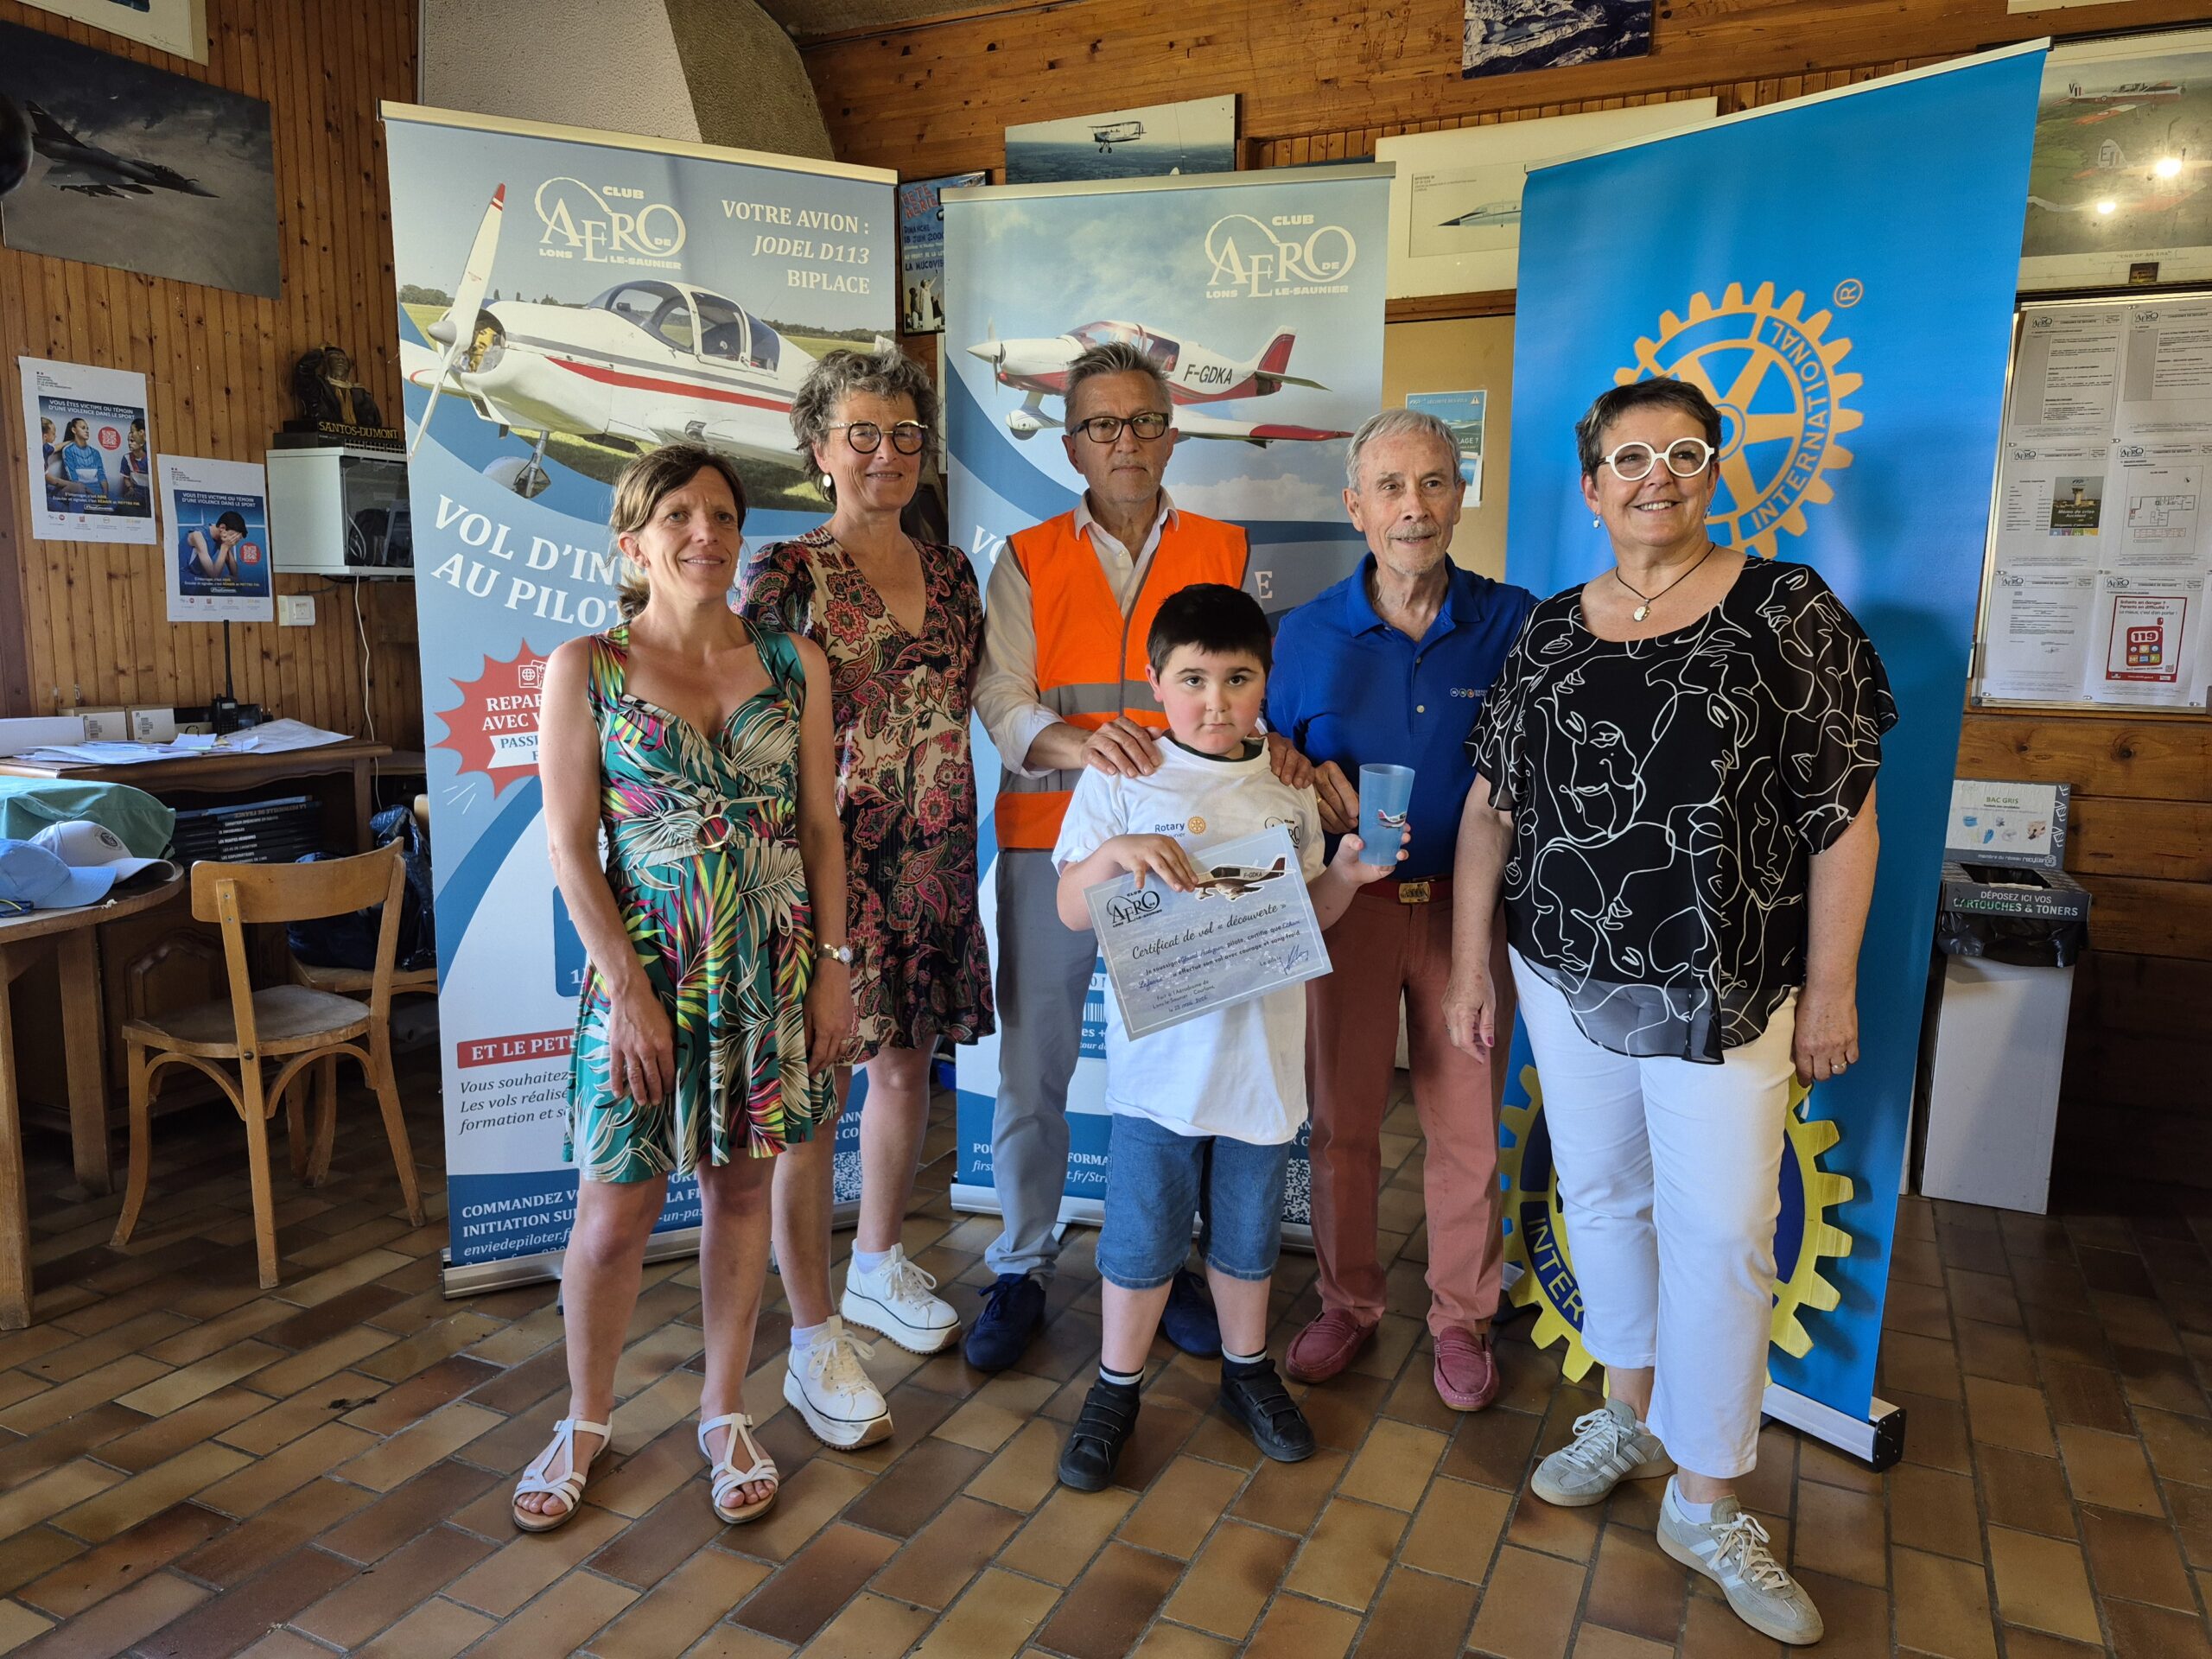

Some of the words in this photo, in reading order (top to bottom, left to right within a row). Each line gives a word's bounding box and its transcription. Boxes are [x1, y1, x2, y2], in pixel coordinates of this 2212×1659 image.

[602, 186, 645, 200] CLUB
[721, 200, 792, 226] VOTRE
[797, 210, 858, 234] AVION
[1271, 214, 1314, 226] CLUB
[539, 198, 687, 263] AERO
[653, 238, 672, 247] DE
[752, 235, 816, 260] JODEL
[820, 244, 871, 264] D113
[539, 248, 573, 259] LONS
[609, 256, 683, 270] LE-SAUNIER
[1206, 226, 1357, 298] AERO
[1321, 262, 1340, 270] DE
[787, 270, 871, 295] BIPLACE
[1206, 289, 1238, 299] LONS
[1274, 285, 1349, 296] LE-SAUNIER
[1183, 364, 1233, 385] F-GDKA
[48, 404, 67, 413] D'UNE
[67, 407, 95, 416] VIOLENCE
[79, 403, 102, 411] VICTIME
[319, 421, 399, 440] SANTOS-DUMONT
[1750, 321, 1829, 531] INTERNATIONAL
[435, 494, 514, 561] VOL
[430, 553, 501, 598] AU
[2133, 632, 2157, 642] 119
[482, 713, 530, 732] AVEC
[1154, 823, 1185, 833] Rotary
[1112, 890, 1160, 924] AERO
[1980, 890, 2019, 902] DÉPOSEZ
[2034, 895, 2052, 904] VOS
[2037, 905, 2079, 917] TONERS
[1132, 934, 1180, 960] Certificat
[1183, 929, 1196, 943] de
[1198, 921, 1214, 938] vol
[1226, 903, 1279, 928] découverte
[1247, 930, 1268, 941] certifie
[1270, 925, 1281, 934] que
[1214, 955, 1224, 963] vol
[1224, 951, 1238, 960] avec
[1239, 944, 1262, 955] courage
[472, 1043, 498, 1061] ET
[502, 1040, 526, 1058] LE
[460, 1079, 495, 1096] Vous
[498, 1069, 569, 1089] souhaitez
[460, 1100, 485, 1114] Les
[489, 1094, 518, 1109] vols
[458, 1111, 535, 1136] formation
[539, 1108, 554, 1121] et
[461, 1192, 563, 1218] COMMANDEZ
[462, 1212, 550, 1238] INITIATION
